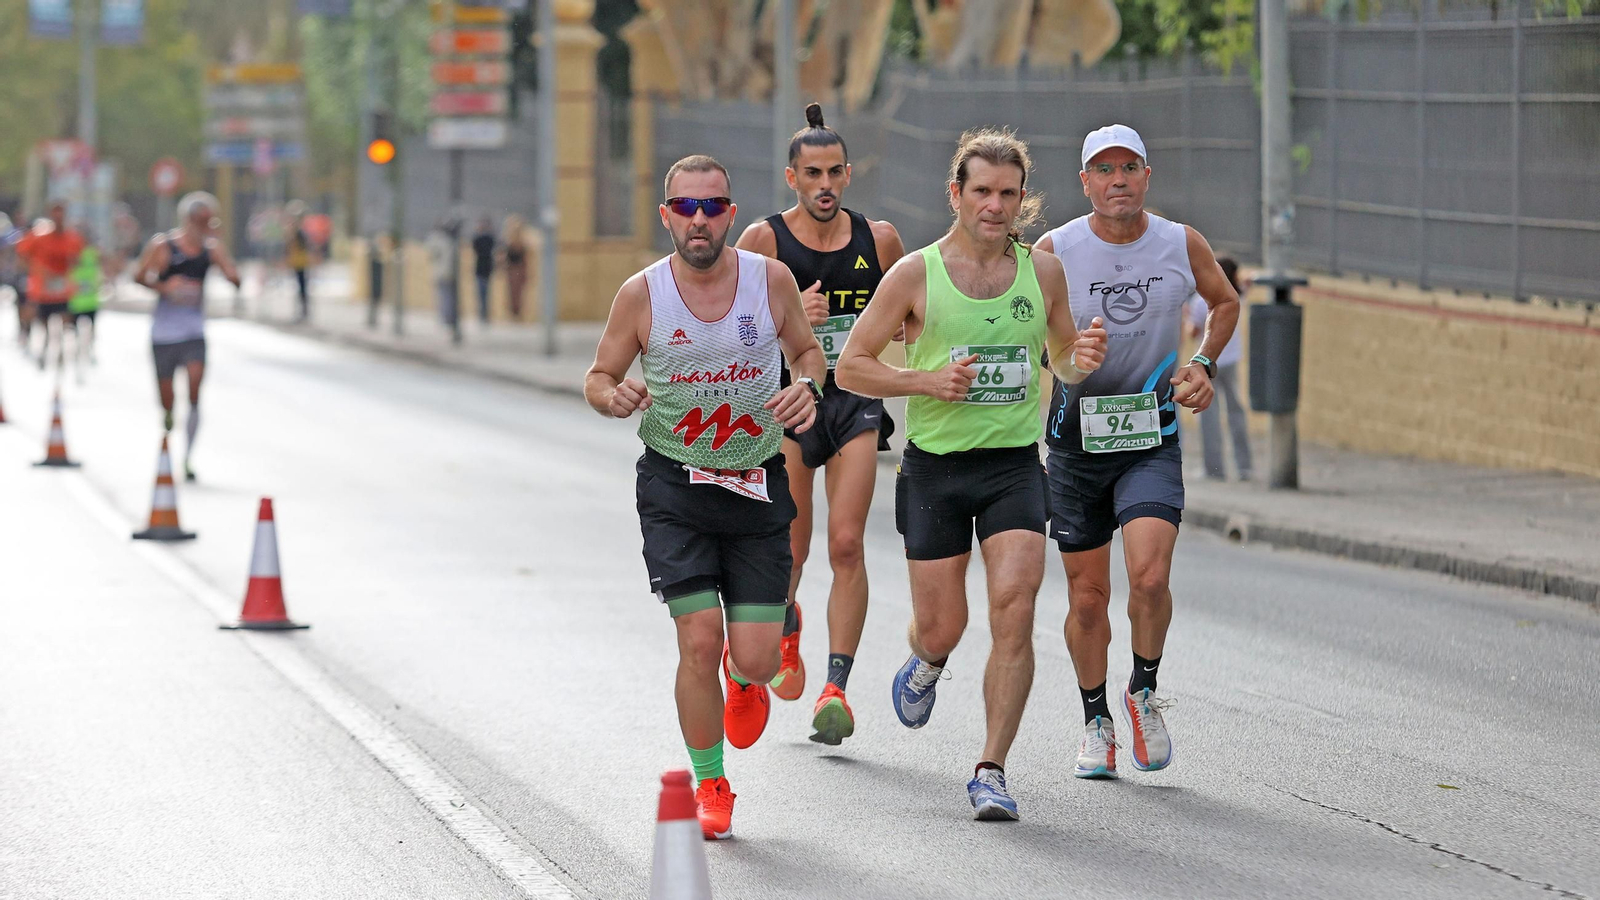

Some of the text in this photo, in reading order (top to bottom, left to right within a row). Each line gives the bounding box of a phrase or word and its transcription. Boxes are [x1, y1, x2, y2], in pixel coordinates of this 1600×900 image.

[669, 360, 764, 384] maratón
[977, 365, 1005, 386] 66
[694, 387, 740, 398] JEREZ
[1106, 413, 1134, 434] 94
